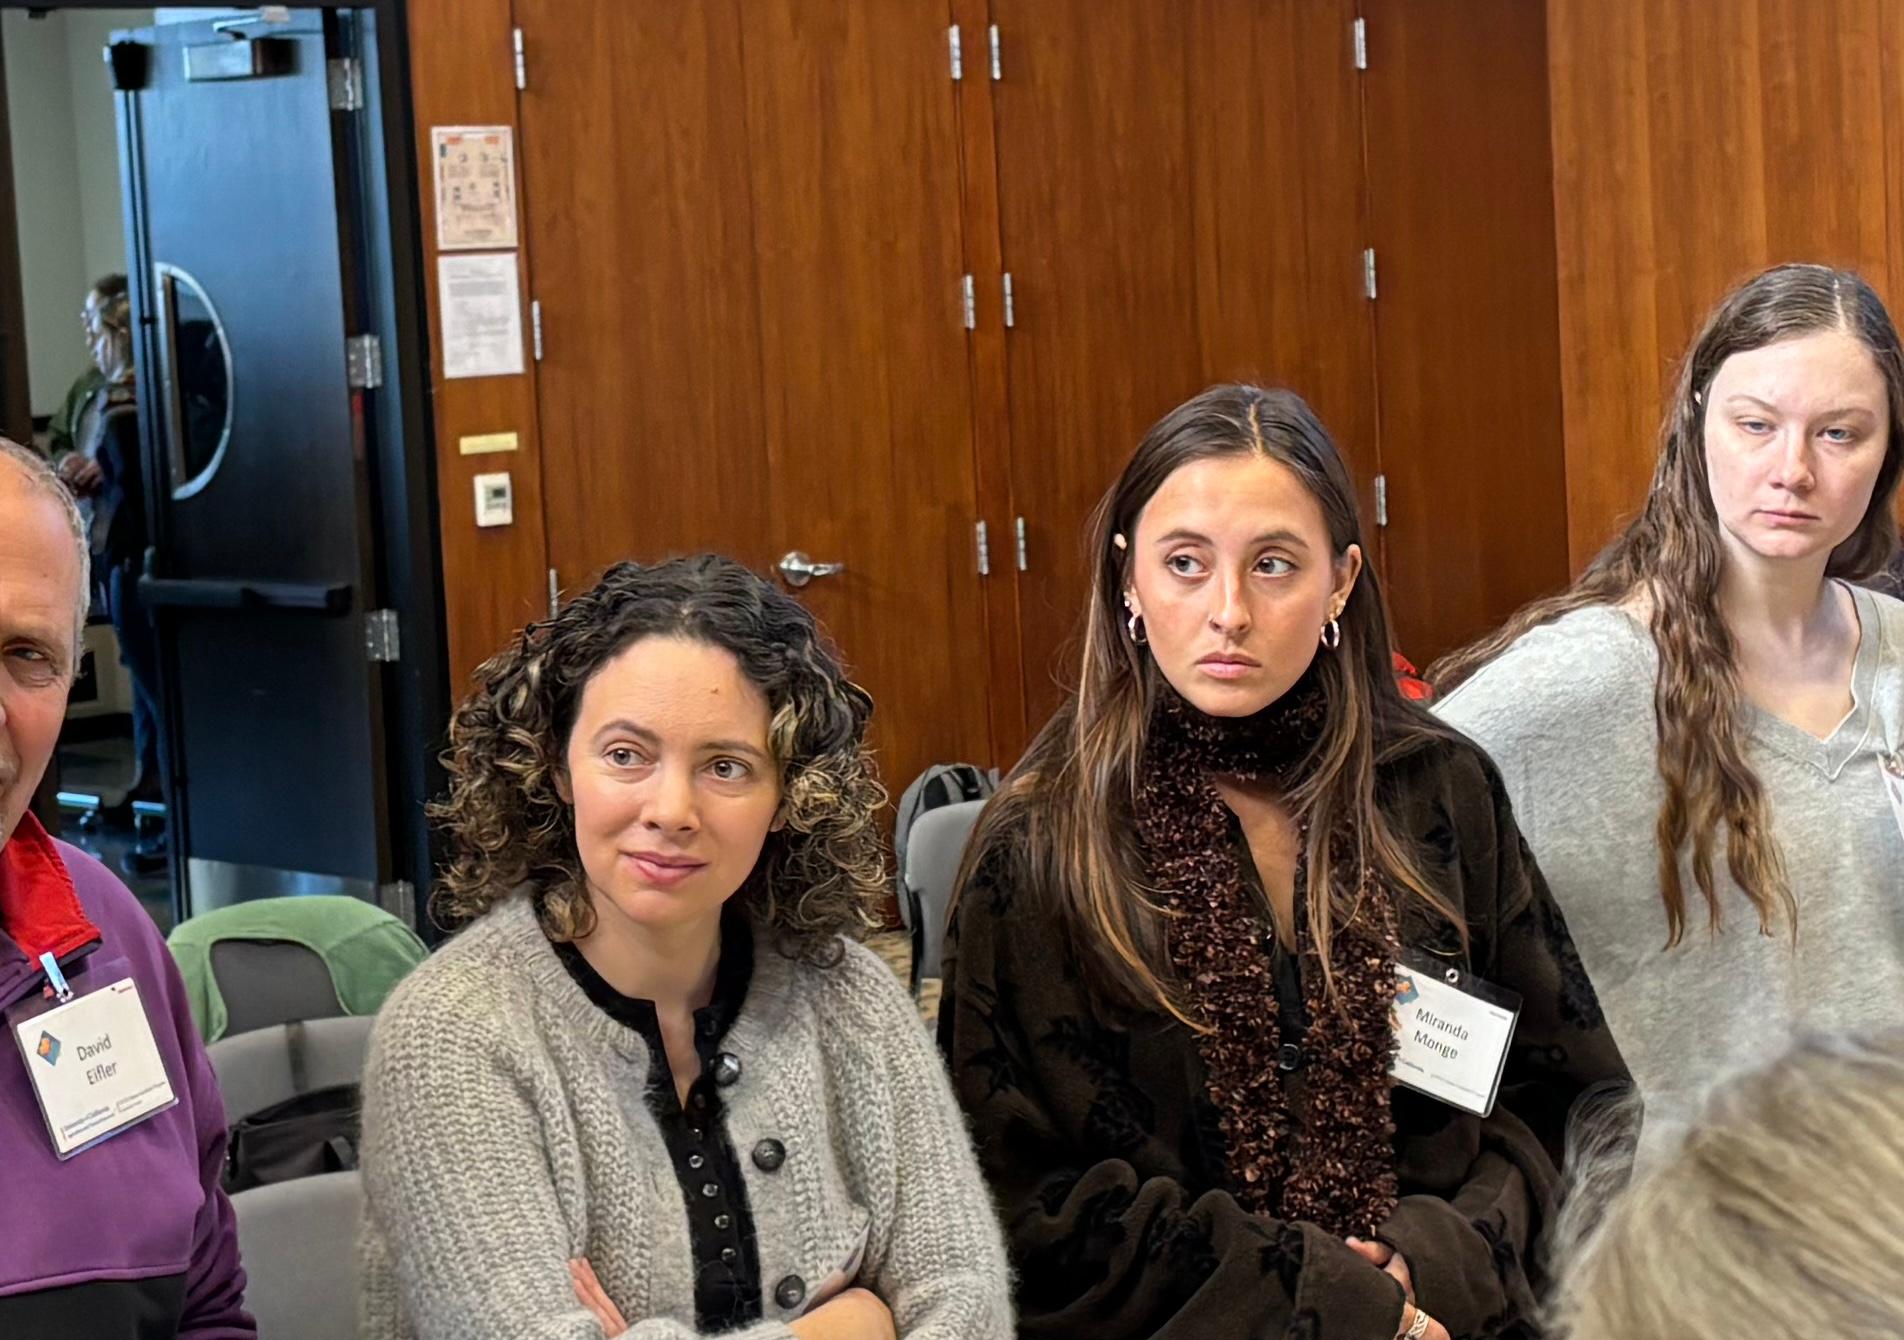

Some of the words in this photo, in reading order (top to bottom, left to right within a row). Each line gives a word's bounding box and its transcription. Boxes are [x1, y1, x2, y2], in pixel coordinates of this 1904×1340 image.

[1415, 1007, 1469, 1042] Miranda
[76, 1032, 112, 1062] David
[86, 1061, 118, 1086] Eifler
